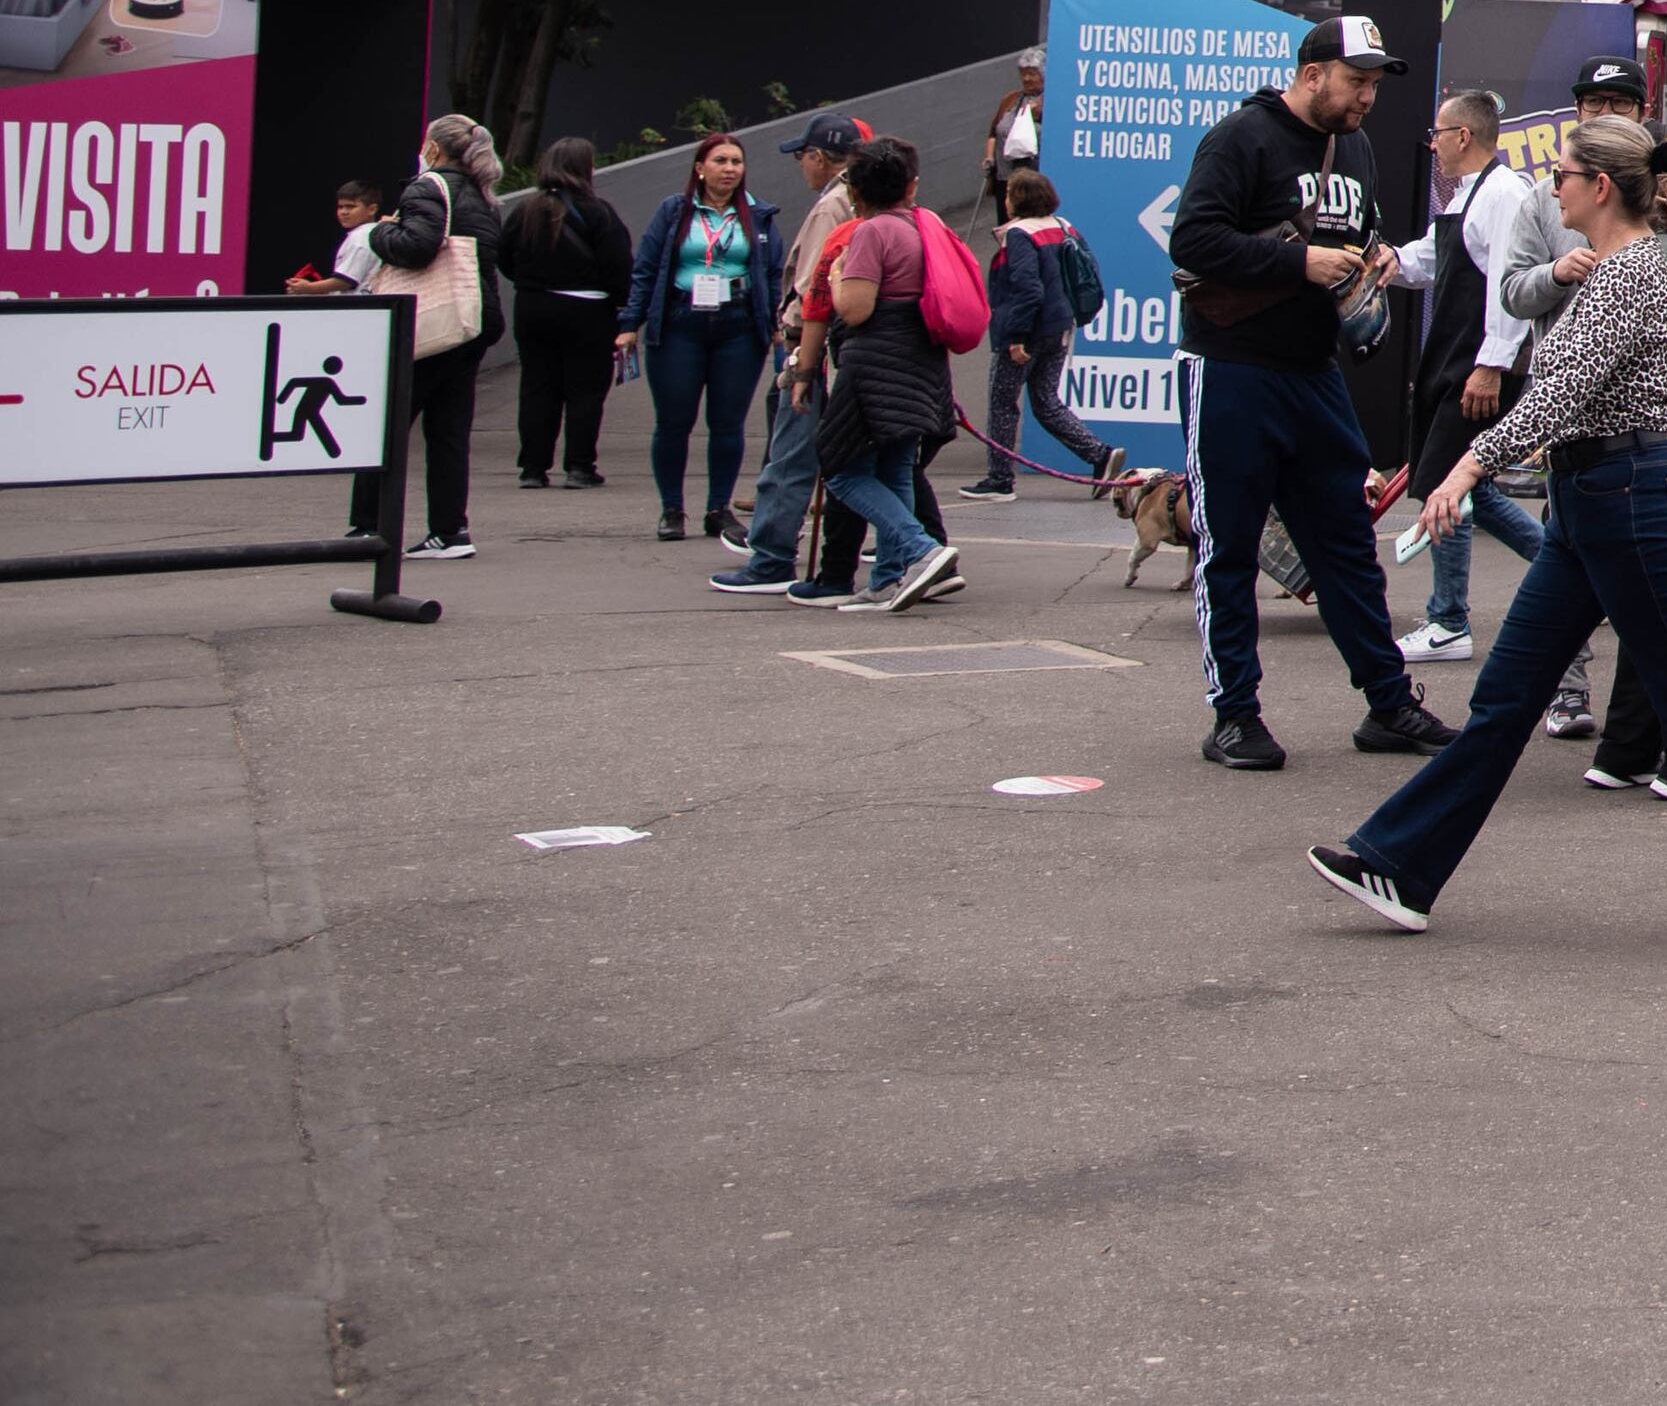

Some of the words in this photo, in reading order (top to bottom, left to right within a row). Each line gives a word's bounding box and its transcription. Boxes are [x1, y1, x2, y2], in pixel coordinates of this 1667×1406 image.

[1079, 25, 1197, 56] UTENSILIOS
[1201, 28, 1228, 57] DE
[1232, 30, 1291, 59] MESA
[1076, 61, 1089, 86] Y
[1094, 61, 1179, 95] COCINA,
[1599, 64, 1621, 74] NIKE
[1074, 95, 1183, 126] SERVICIOS
[1073, 129, 1096, 157] EL
[1101, 130, 1172, 161] HOGAR
[3, 120, 226, 255] VISITA
[74, 363, 216, 398] SALIDA
[1066, 365, 1150, 410] Nivel
[1161, 370, 1173, 411] 1
[117, 406, 171, 430] EXIT
